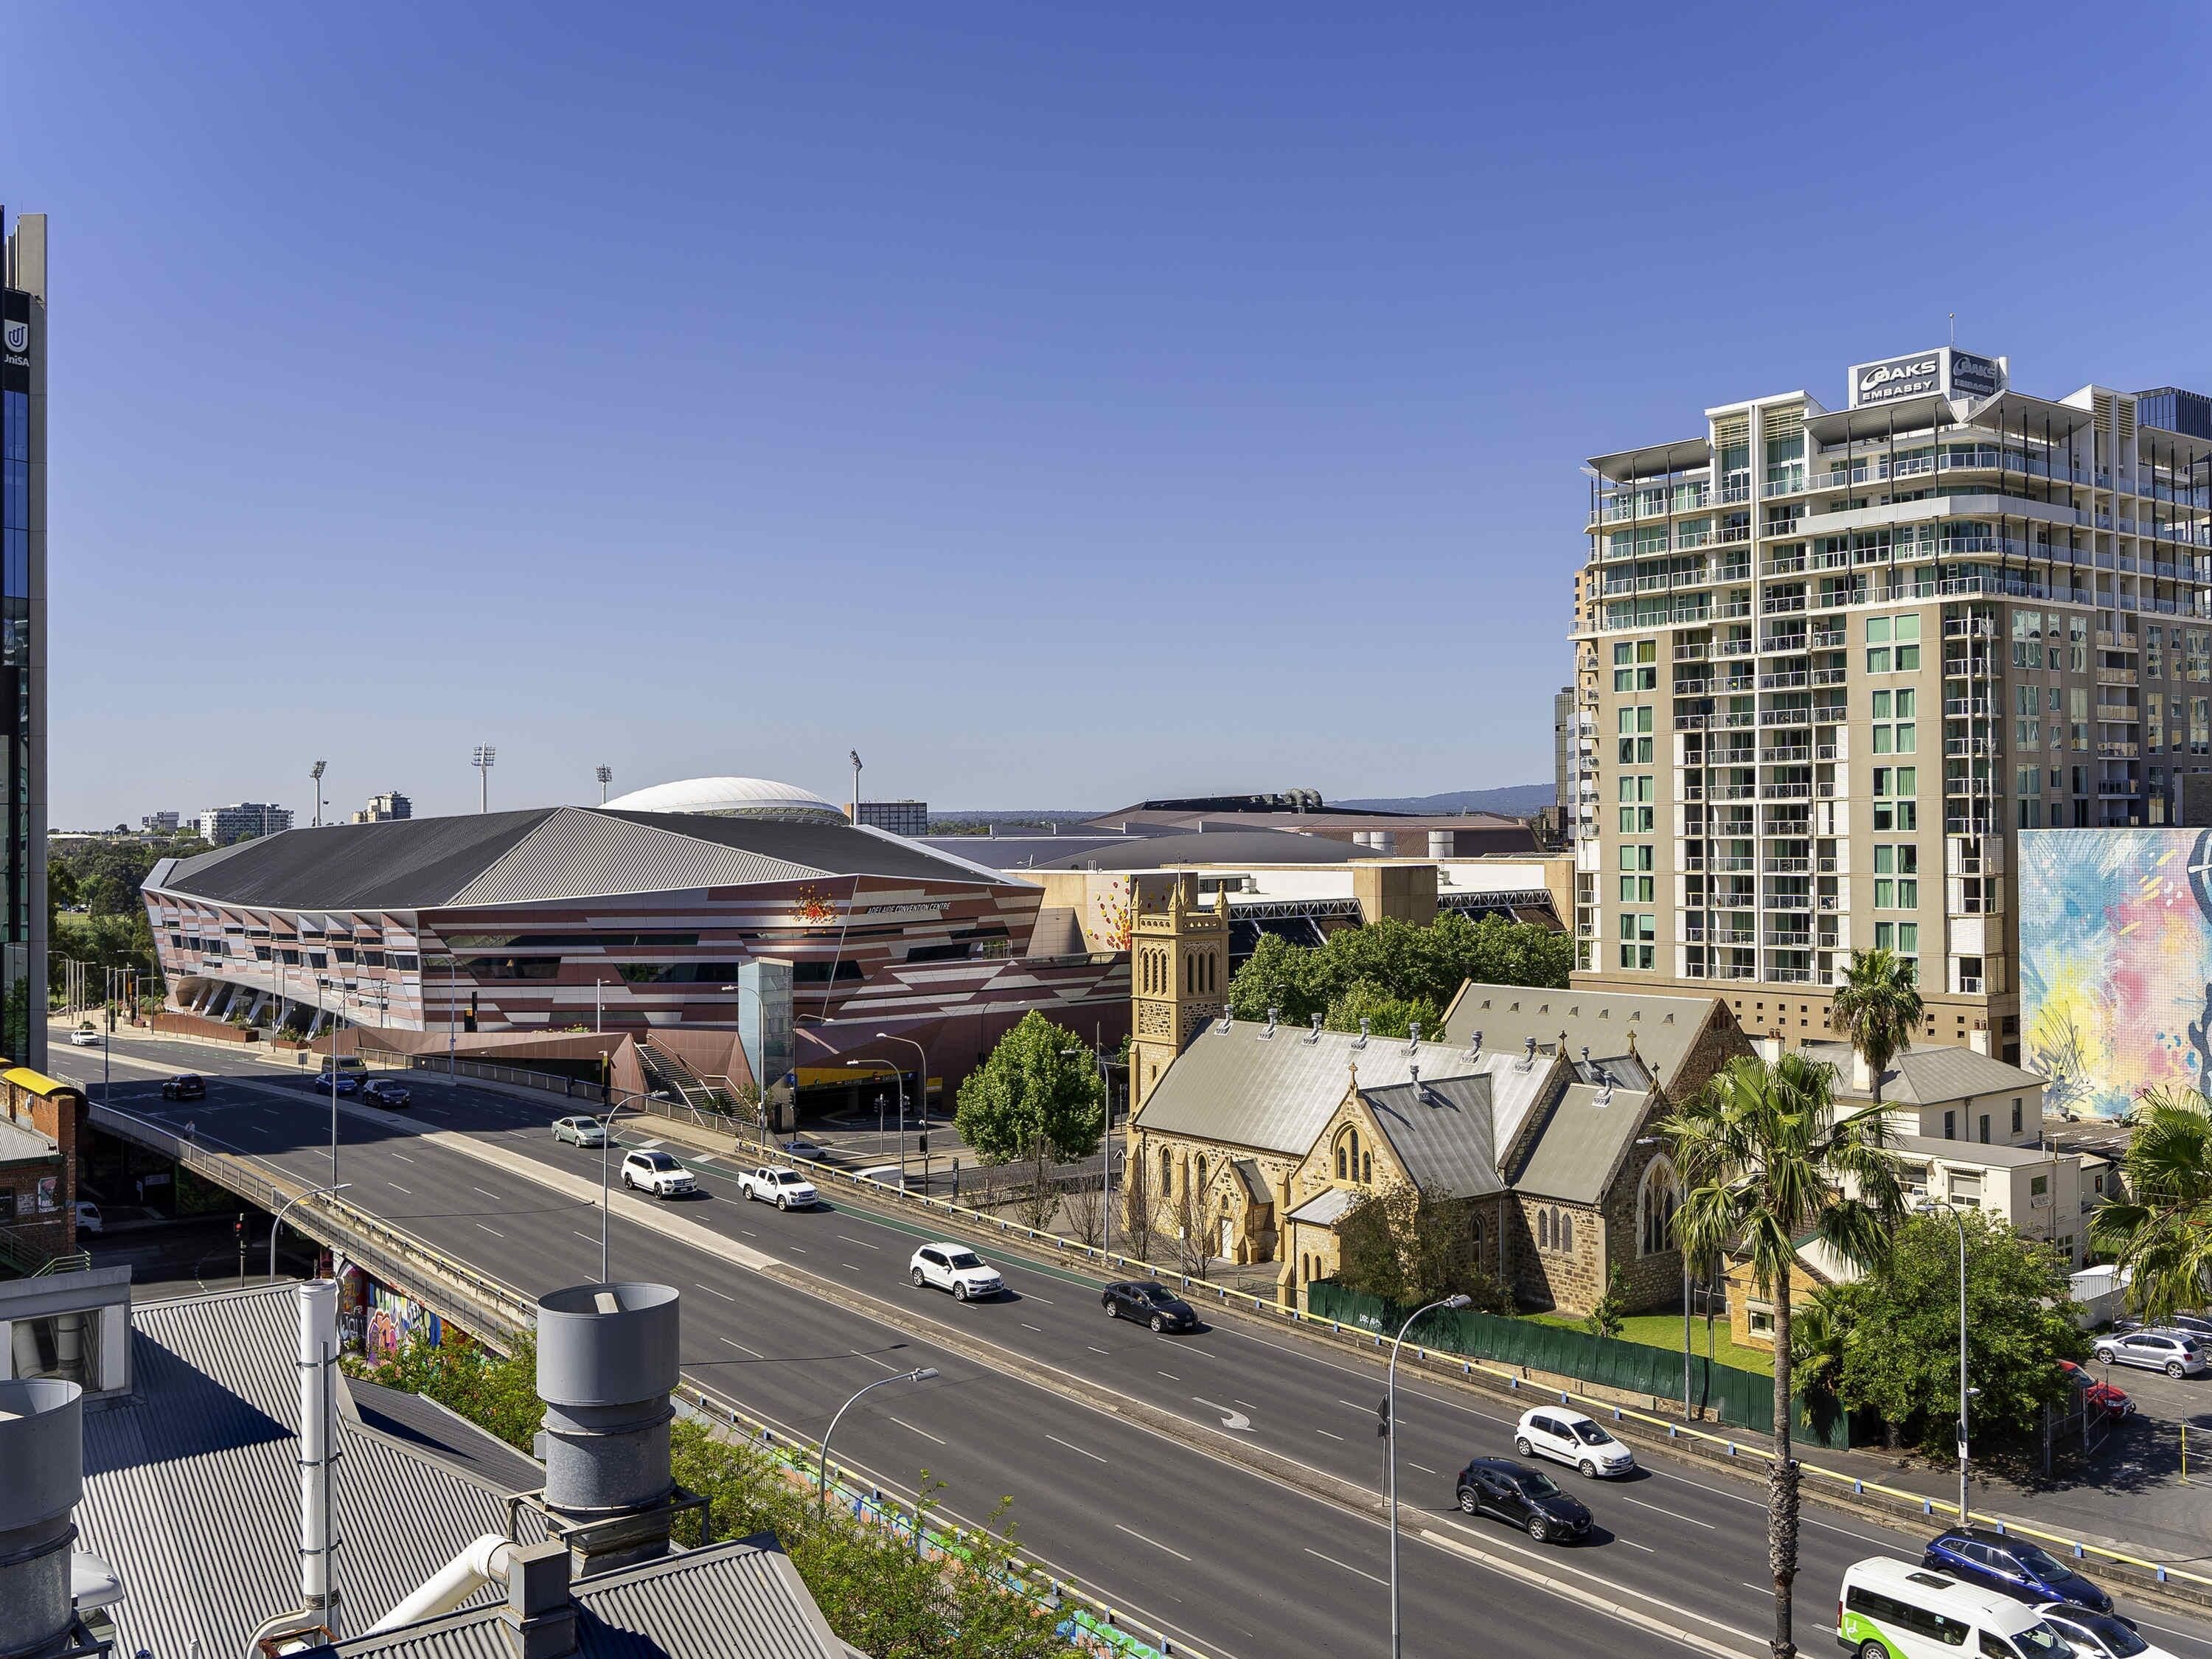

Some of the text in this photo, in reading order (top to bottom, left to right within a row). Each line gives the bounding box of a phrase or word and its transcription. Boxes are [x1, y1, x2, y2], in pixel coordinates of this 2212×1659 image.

[1860, 360, 1936, 391] OAKS
[1863, 380, 1933, 401] EMBASSY
[867, 902, 951, 915] ADELAIDE CONVENTION CENTRE
